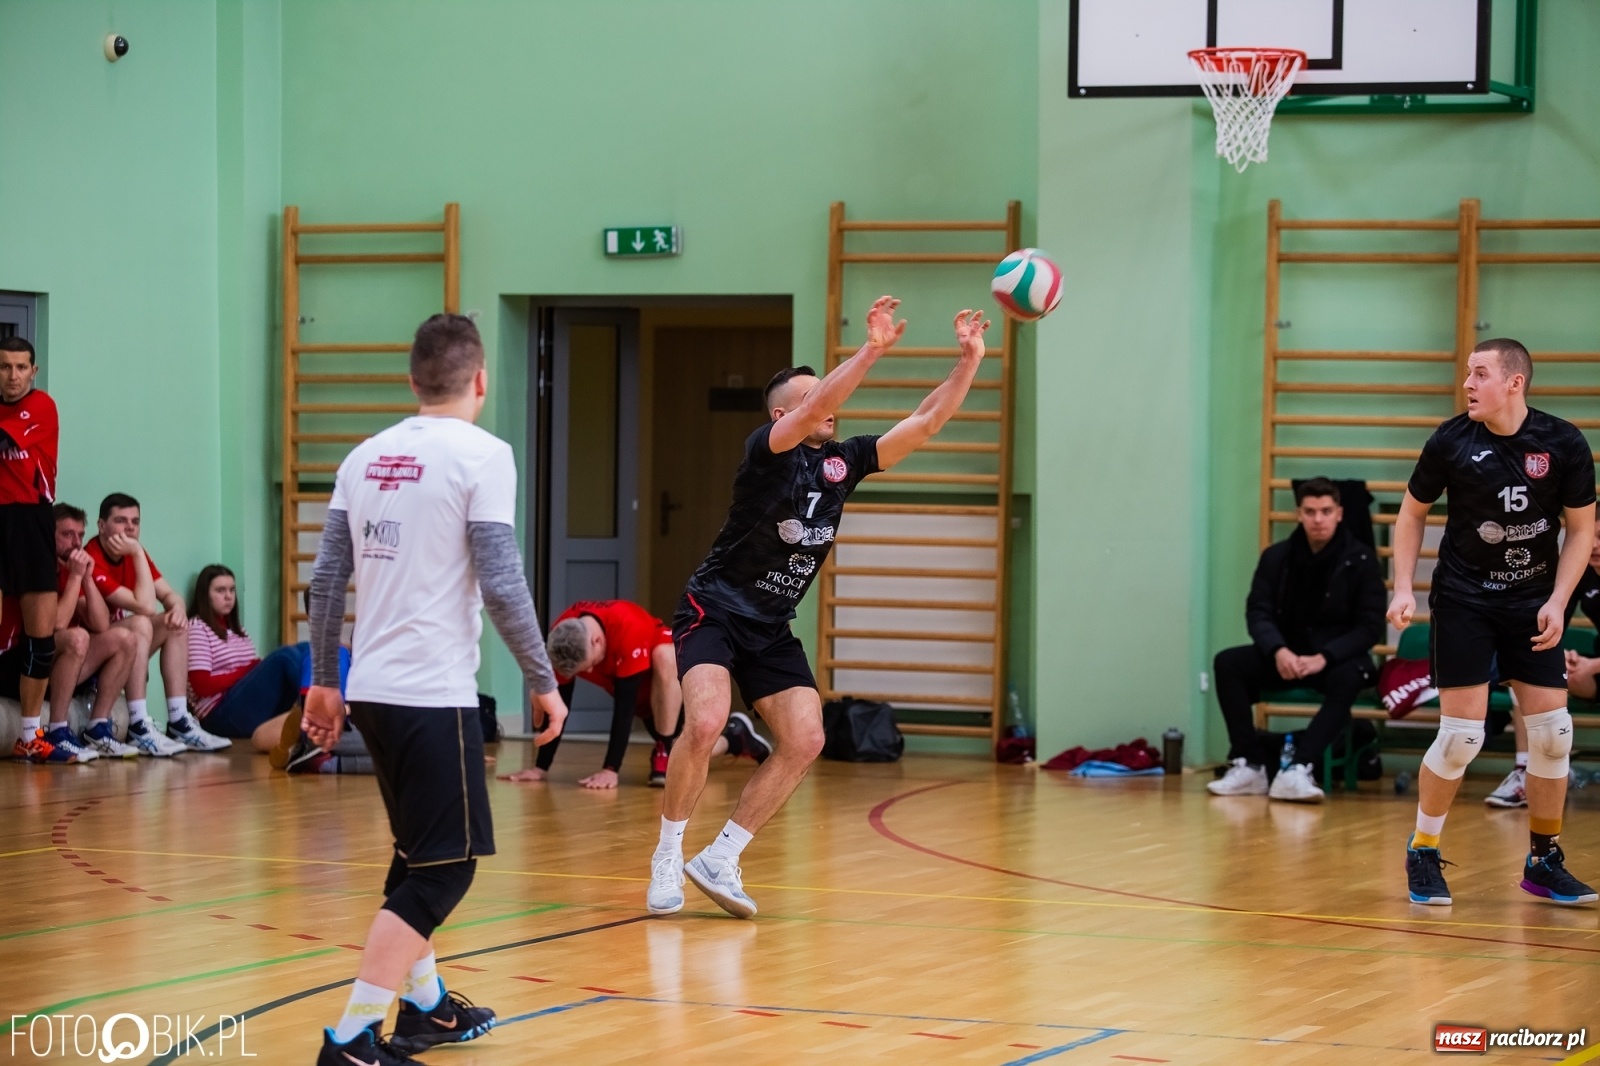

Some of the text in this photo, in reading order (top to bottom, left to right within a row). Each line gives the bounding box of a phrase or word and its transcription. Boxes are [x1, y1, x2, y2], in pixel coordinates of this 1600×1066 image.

[806, 492, 822, 518] 7
[1498, 486, 1528, 512] 15
[1506, 518, 1550, 541] DYMEL
[785, 589, 800, 599] JĘZ
